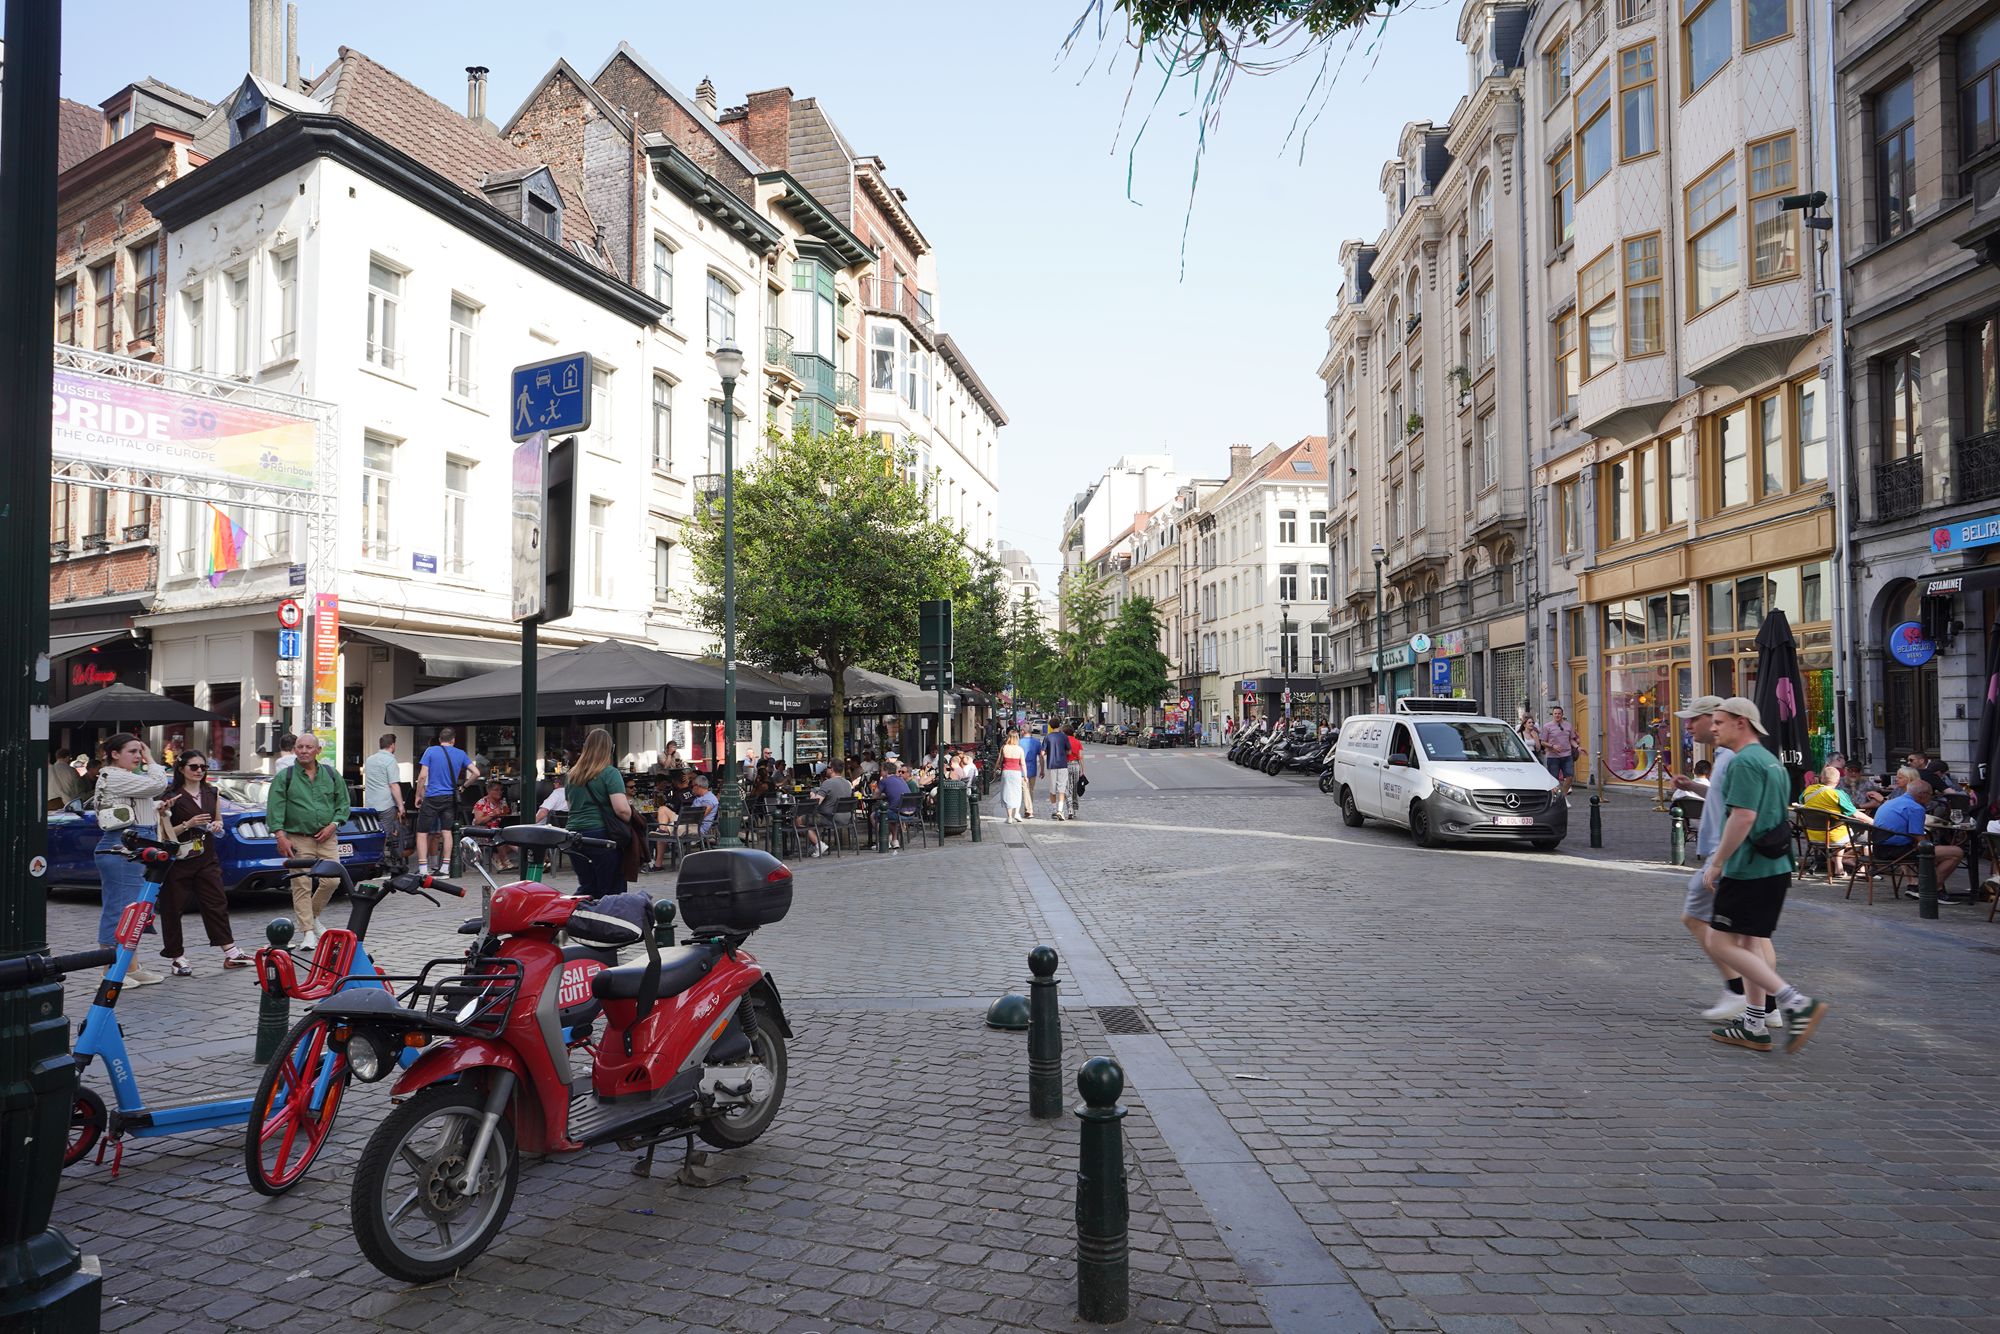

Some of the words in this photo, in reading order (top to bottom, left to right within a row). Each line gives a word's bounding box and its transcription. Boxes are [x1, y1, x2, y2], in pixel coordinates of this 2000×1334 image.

[181, 407, 217, 431] 30
[55, 426, 82, 441] THE
[86, 432, 141, 450] CAPITAL
[146, 442, 162, 453] OF
[166, 446, 216, 462] EUROPE
[1926, 577, 1963, 595] ESTAMINET
[1434, 662, 1448, 681] P
[625, 696, 645, 704] COLD
[112, 1058, 128, 1083] dott
